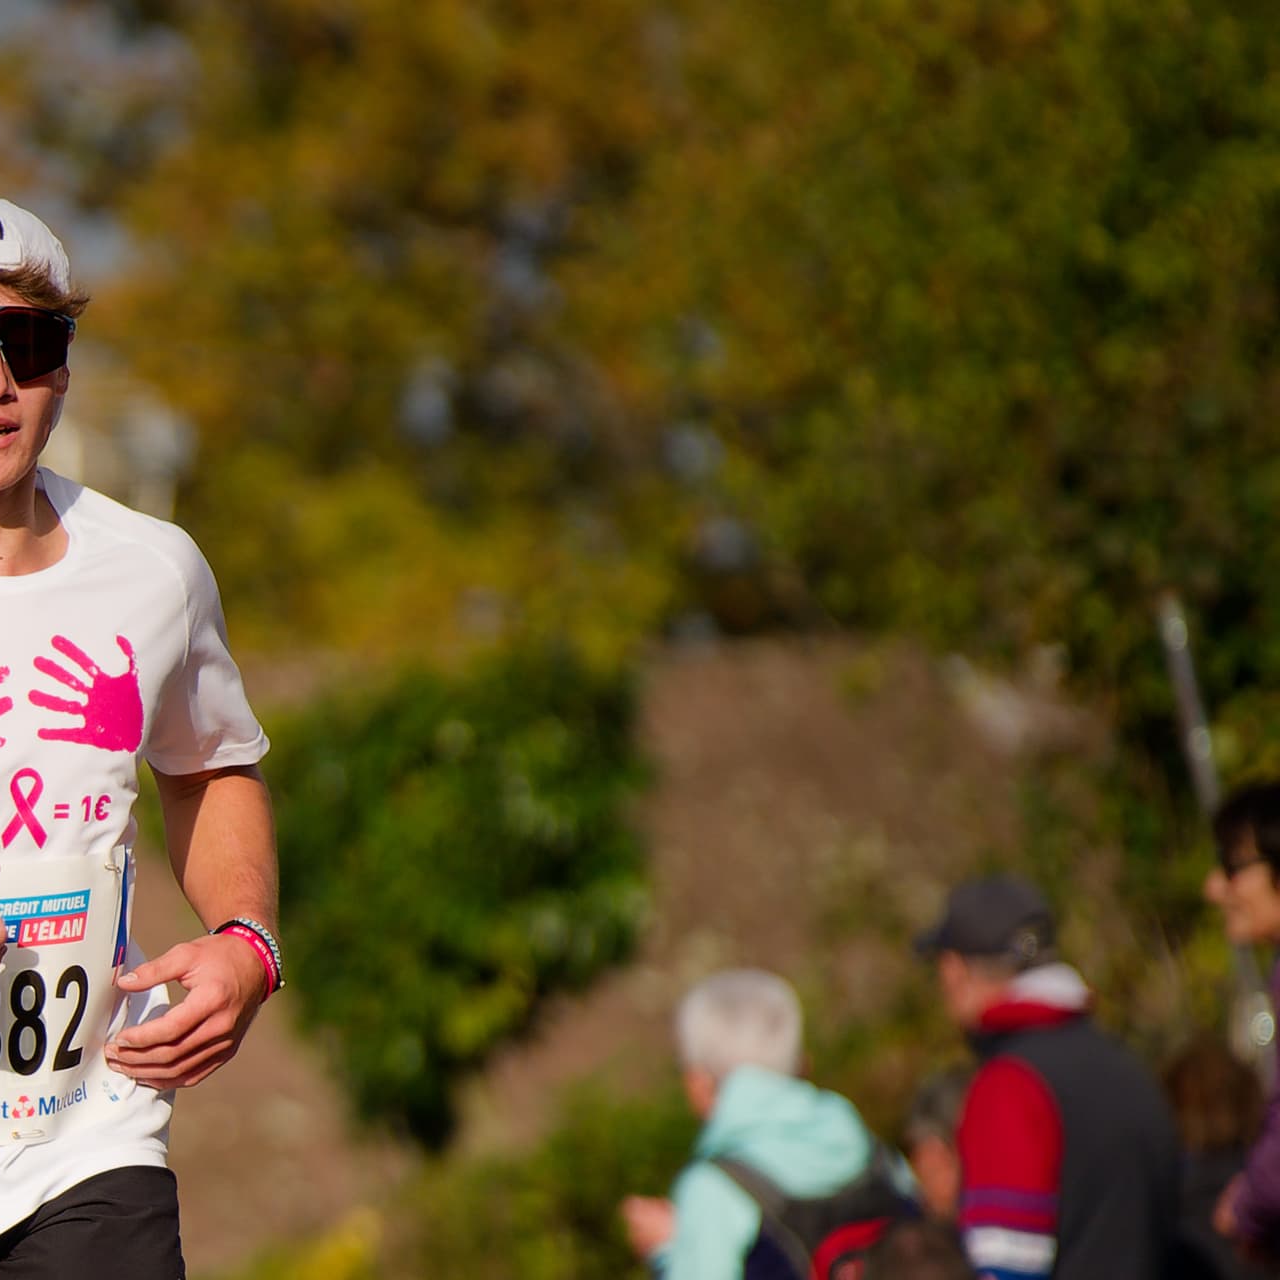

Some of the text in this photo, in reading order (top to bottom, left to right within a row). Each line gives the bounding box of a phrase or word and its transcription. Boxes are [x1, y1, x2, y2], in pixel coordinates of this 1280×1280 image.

[81, 794, 112, 822] 1€
[41, 896, 86, 913] MUTUEL
[22, 918, 84, 943] L'ÉLAN
[38, 1081, 88, 1116] Mutuel
